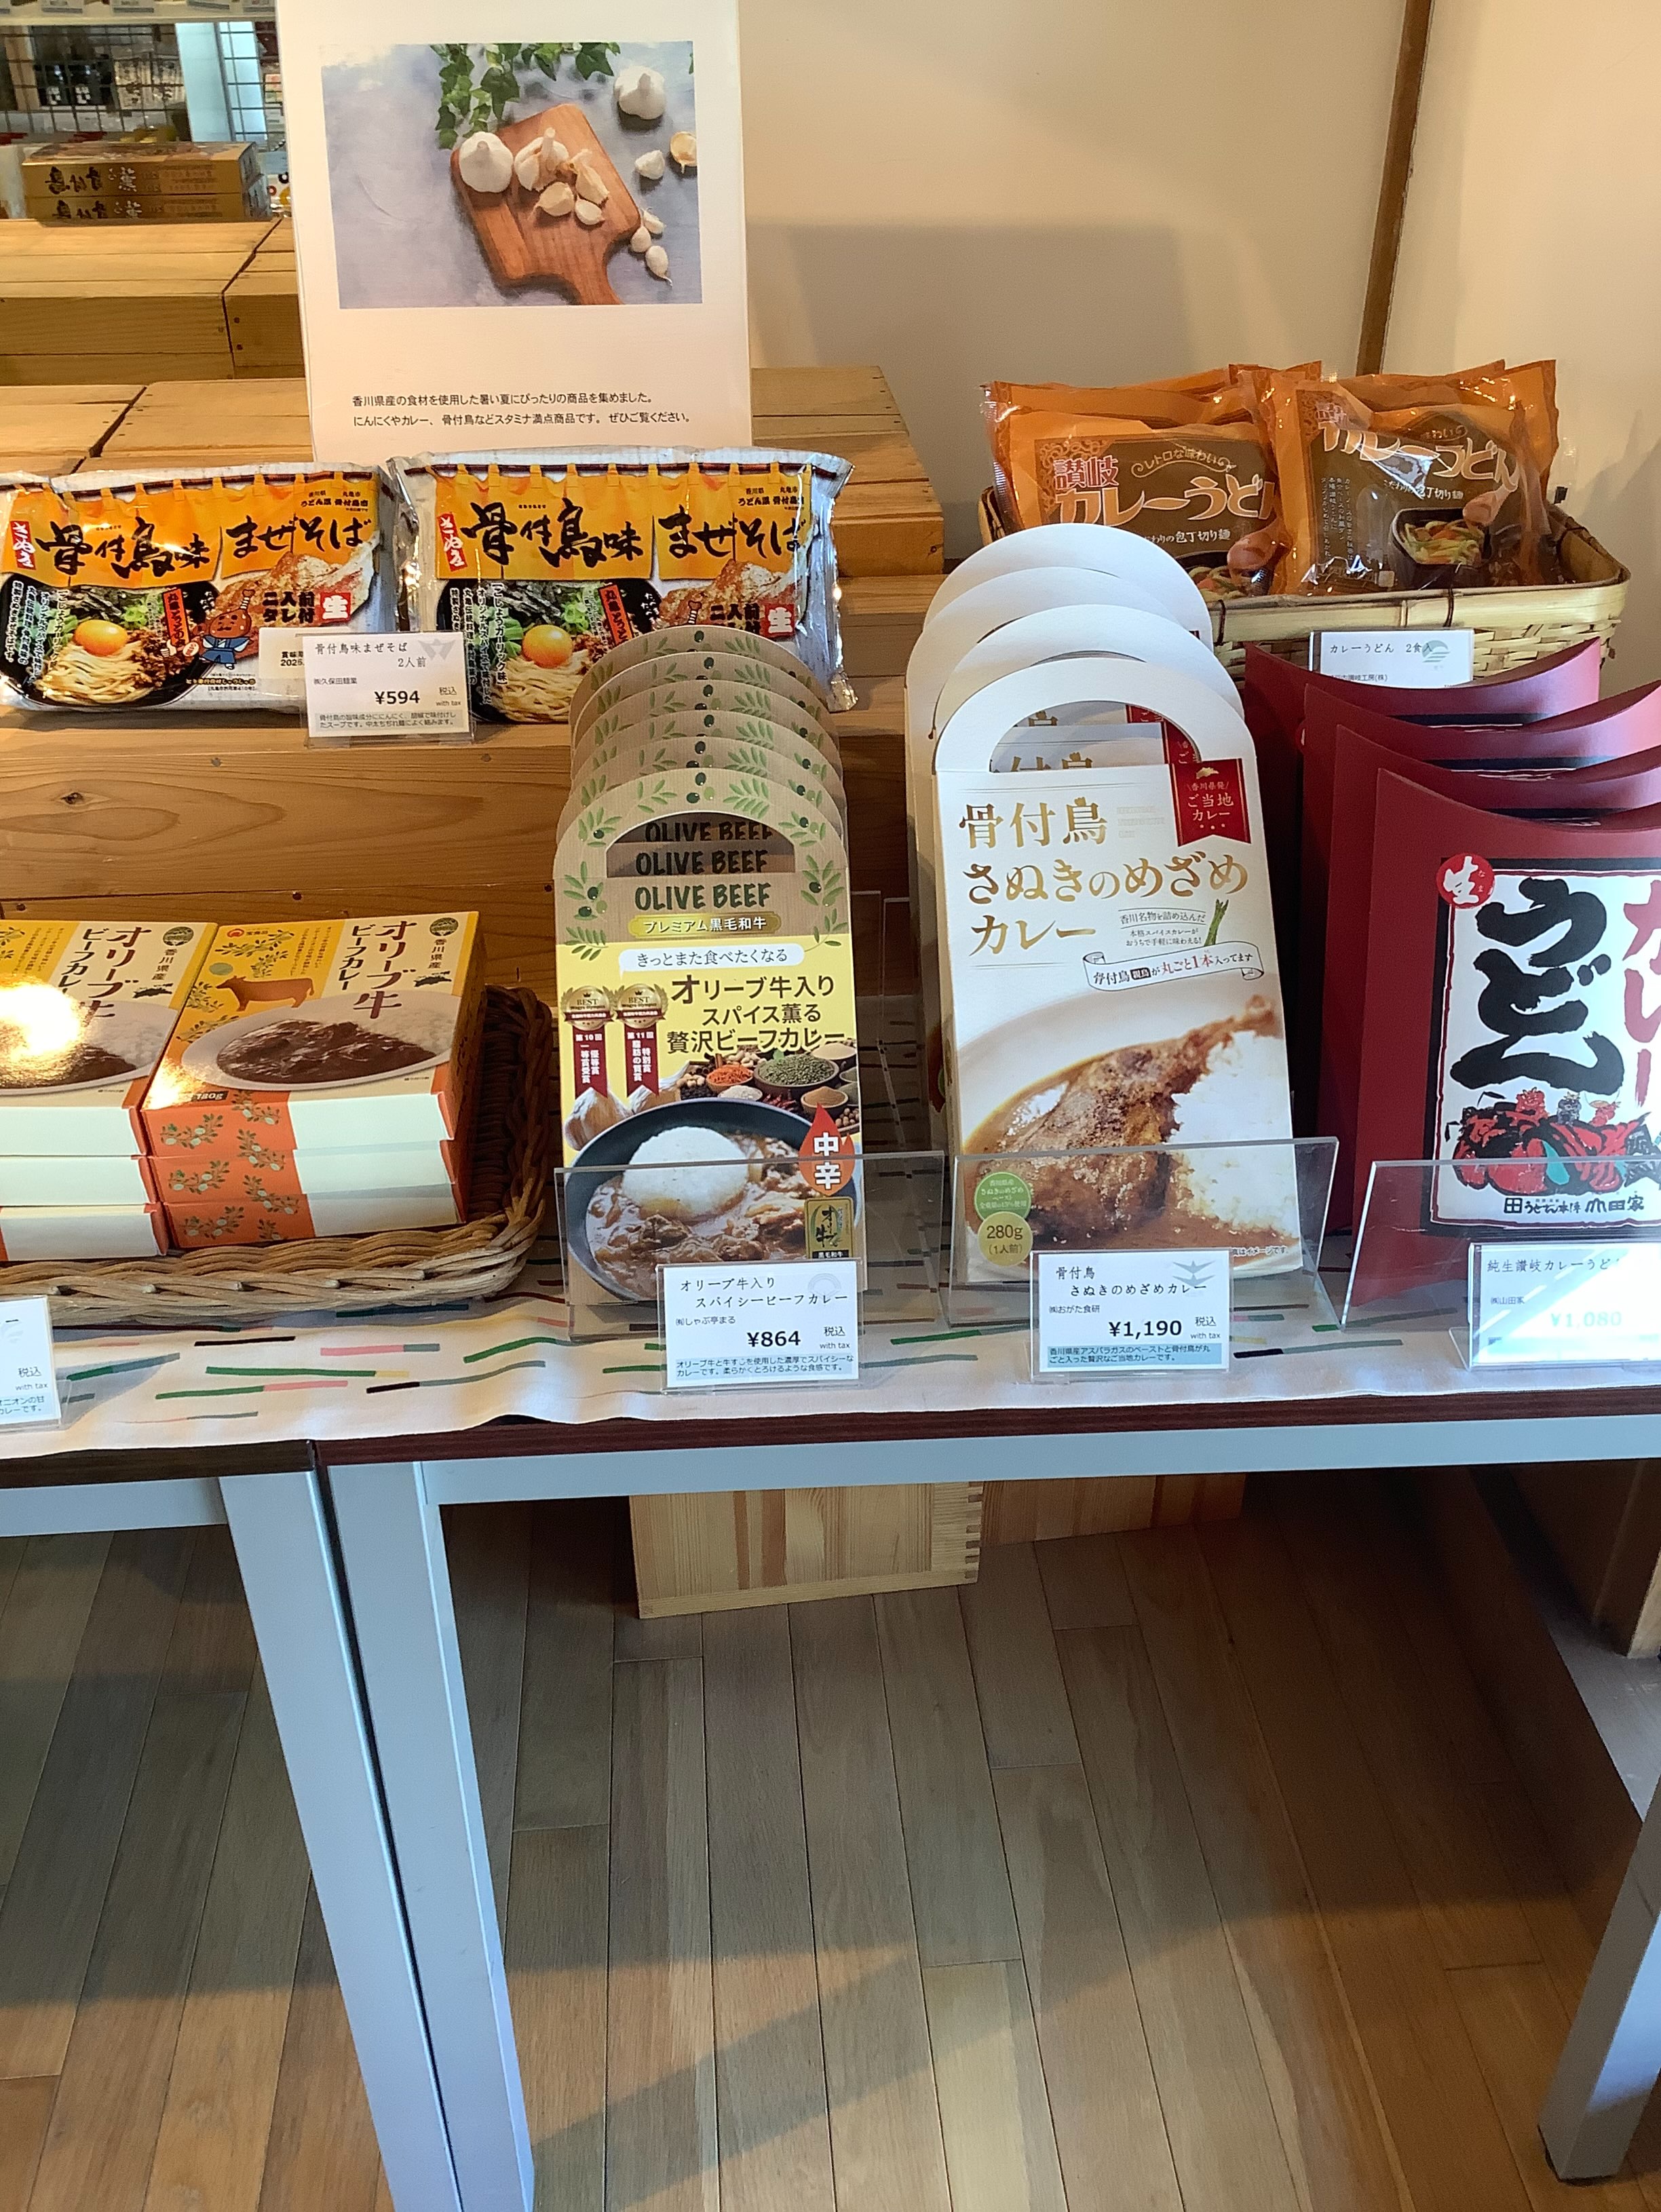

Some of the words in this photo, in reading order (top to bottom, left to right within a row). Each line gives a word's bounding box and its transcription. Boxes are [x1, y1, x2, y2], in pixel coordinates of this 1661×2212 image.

[352, 392, 654, 407] 香川県産の食材を使用した暑い夏にぴったりの商品を集めました。
[1053, 455, 1120, 490] 讃岐
[225, 514, 373, 558] まぜそば
[461, 498, 645, 568] 骨付鳥味
[658, 505, 809, 559] まぜそば
[322, 595, 348, 619] 生
[767, 607, 794, 632] 生
[315, 643, 408, 655] 骨付鳥味まぜそば
[1330, 643, 1394, 653] カレーうどん
[1406, 643, 1433, 653] 2食入
[398, 657, 427, 668] 2人前
[375, 691, 420, 705] ¥594
[439, 687, 457, 696] 税込
[1188, 793, 1234, 807] ご当地
[959, 797, 1107, 848] 骨付鳥
[1193, 809, 1229, 821] カレー
[636, 852, 705, 875] OLIVE
[711, 849, 768, 874] BEEF
[963, 852, 1248, 904] さぬきのめざめ
[1443, 856, 1479, 904] 生
[634, 885, 706, 911] OLIVE
[712, 882, 771, 909] BEEF
[643, 917, 767, 934] プレミアム黒毛和牛
[969, 915, 1096, 956] カレー
[339, 924, 376, 991] ビーフカレー
[637, 949, 788, 968] きっとまた食べたくなる
[353, 921, 417, 1019] オリーブ牛
[671, 974, 835, 1004] オリーブ牛入り
[1450, 877, 1624, 1094] うどん
[702, 1004, 821, 1027] スパイス薫る
[666, 1027, 845, 1054] 贅沢ビーフカレー
[814, 1132, 842, 1189] 中辛
[987, 1225, 1023, 1240] 280g
[1056, 1266, 1095, 1280] 骨付鳥
[1487, 1259, 1620, 1272] 純生讃岐カレーうど
[681, 1277, 775, 1291] オリーブ牛入り
[1071, 1284, 1207, 1296] さぬきのめざめカレー
[695, 1294, 848, 1308] スパイシービーフカレー
[747, 1331, 801, 1347] ¥864
[824, 1327, 845, 1336] 税込
[1109, 1320, 1182, 1339] ¥1,190
[1195, 1316, 1217, 1327] 税込
[18, 1367, 41, 1377] 税込
